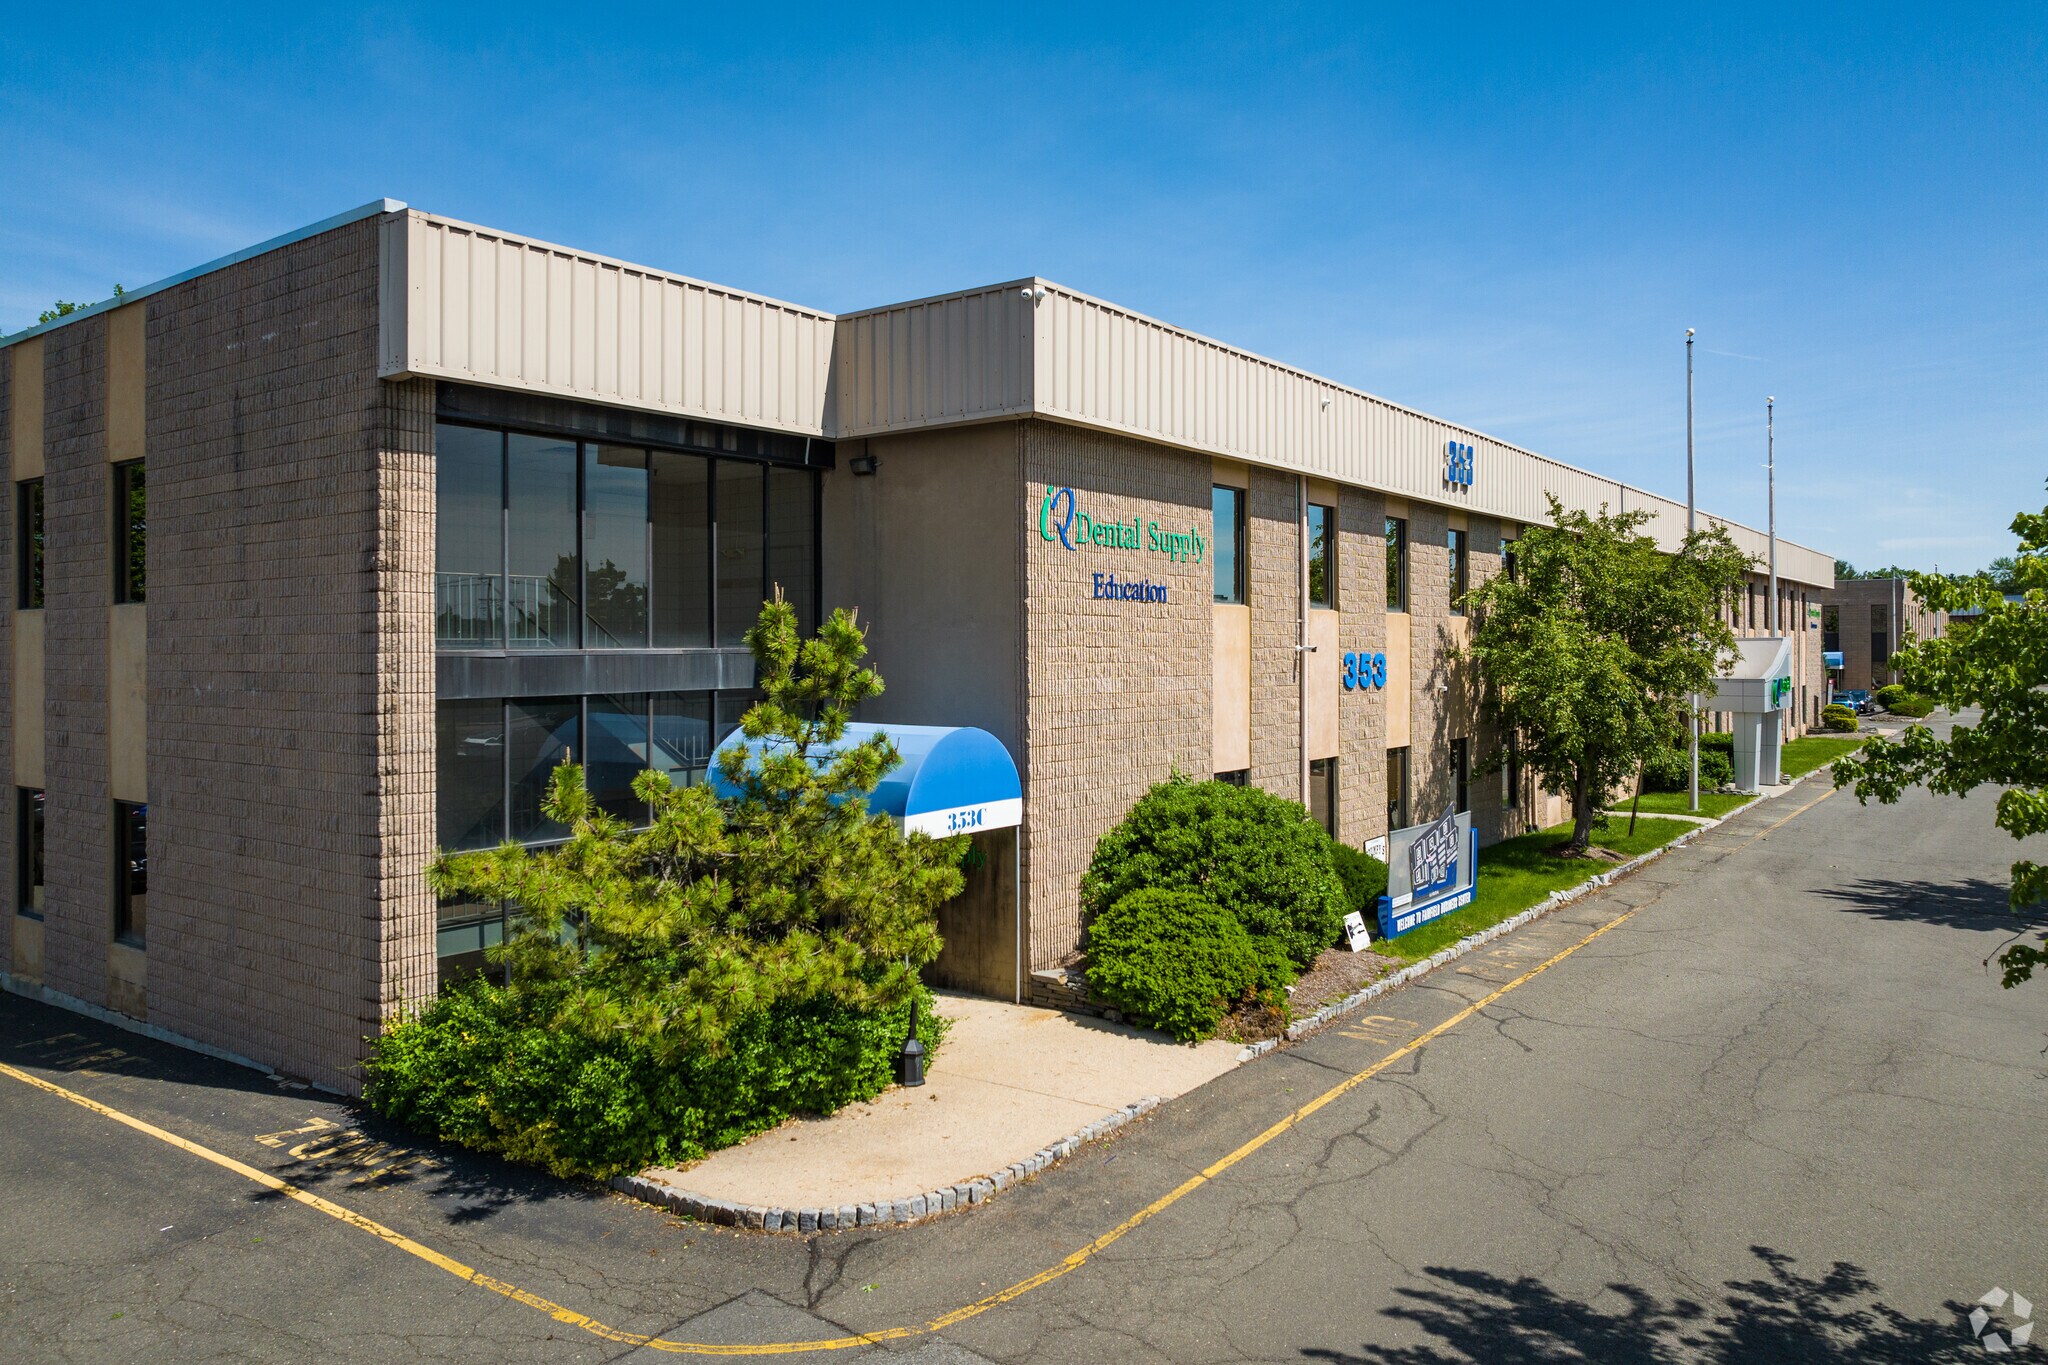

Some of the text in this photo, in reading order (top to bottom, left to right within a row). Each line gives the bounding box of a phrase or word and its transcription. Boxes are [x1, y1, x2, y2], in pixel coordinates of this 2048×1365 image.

[1448, 440, 1473, 486] 353
[1040, 485, 1206, 563] iQ Dental Supply
[1092, 572, 1167, 604] Education
[1343, 651, 1387, 690] 353
[947, 808, 987, 831] 353C
[1337, 1015, 1419, 1045] NO
